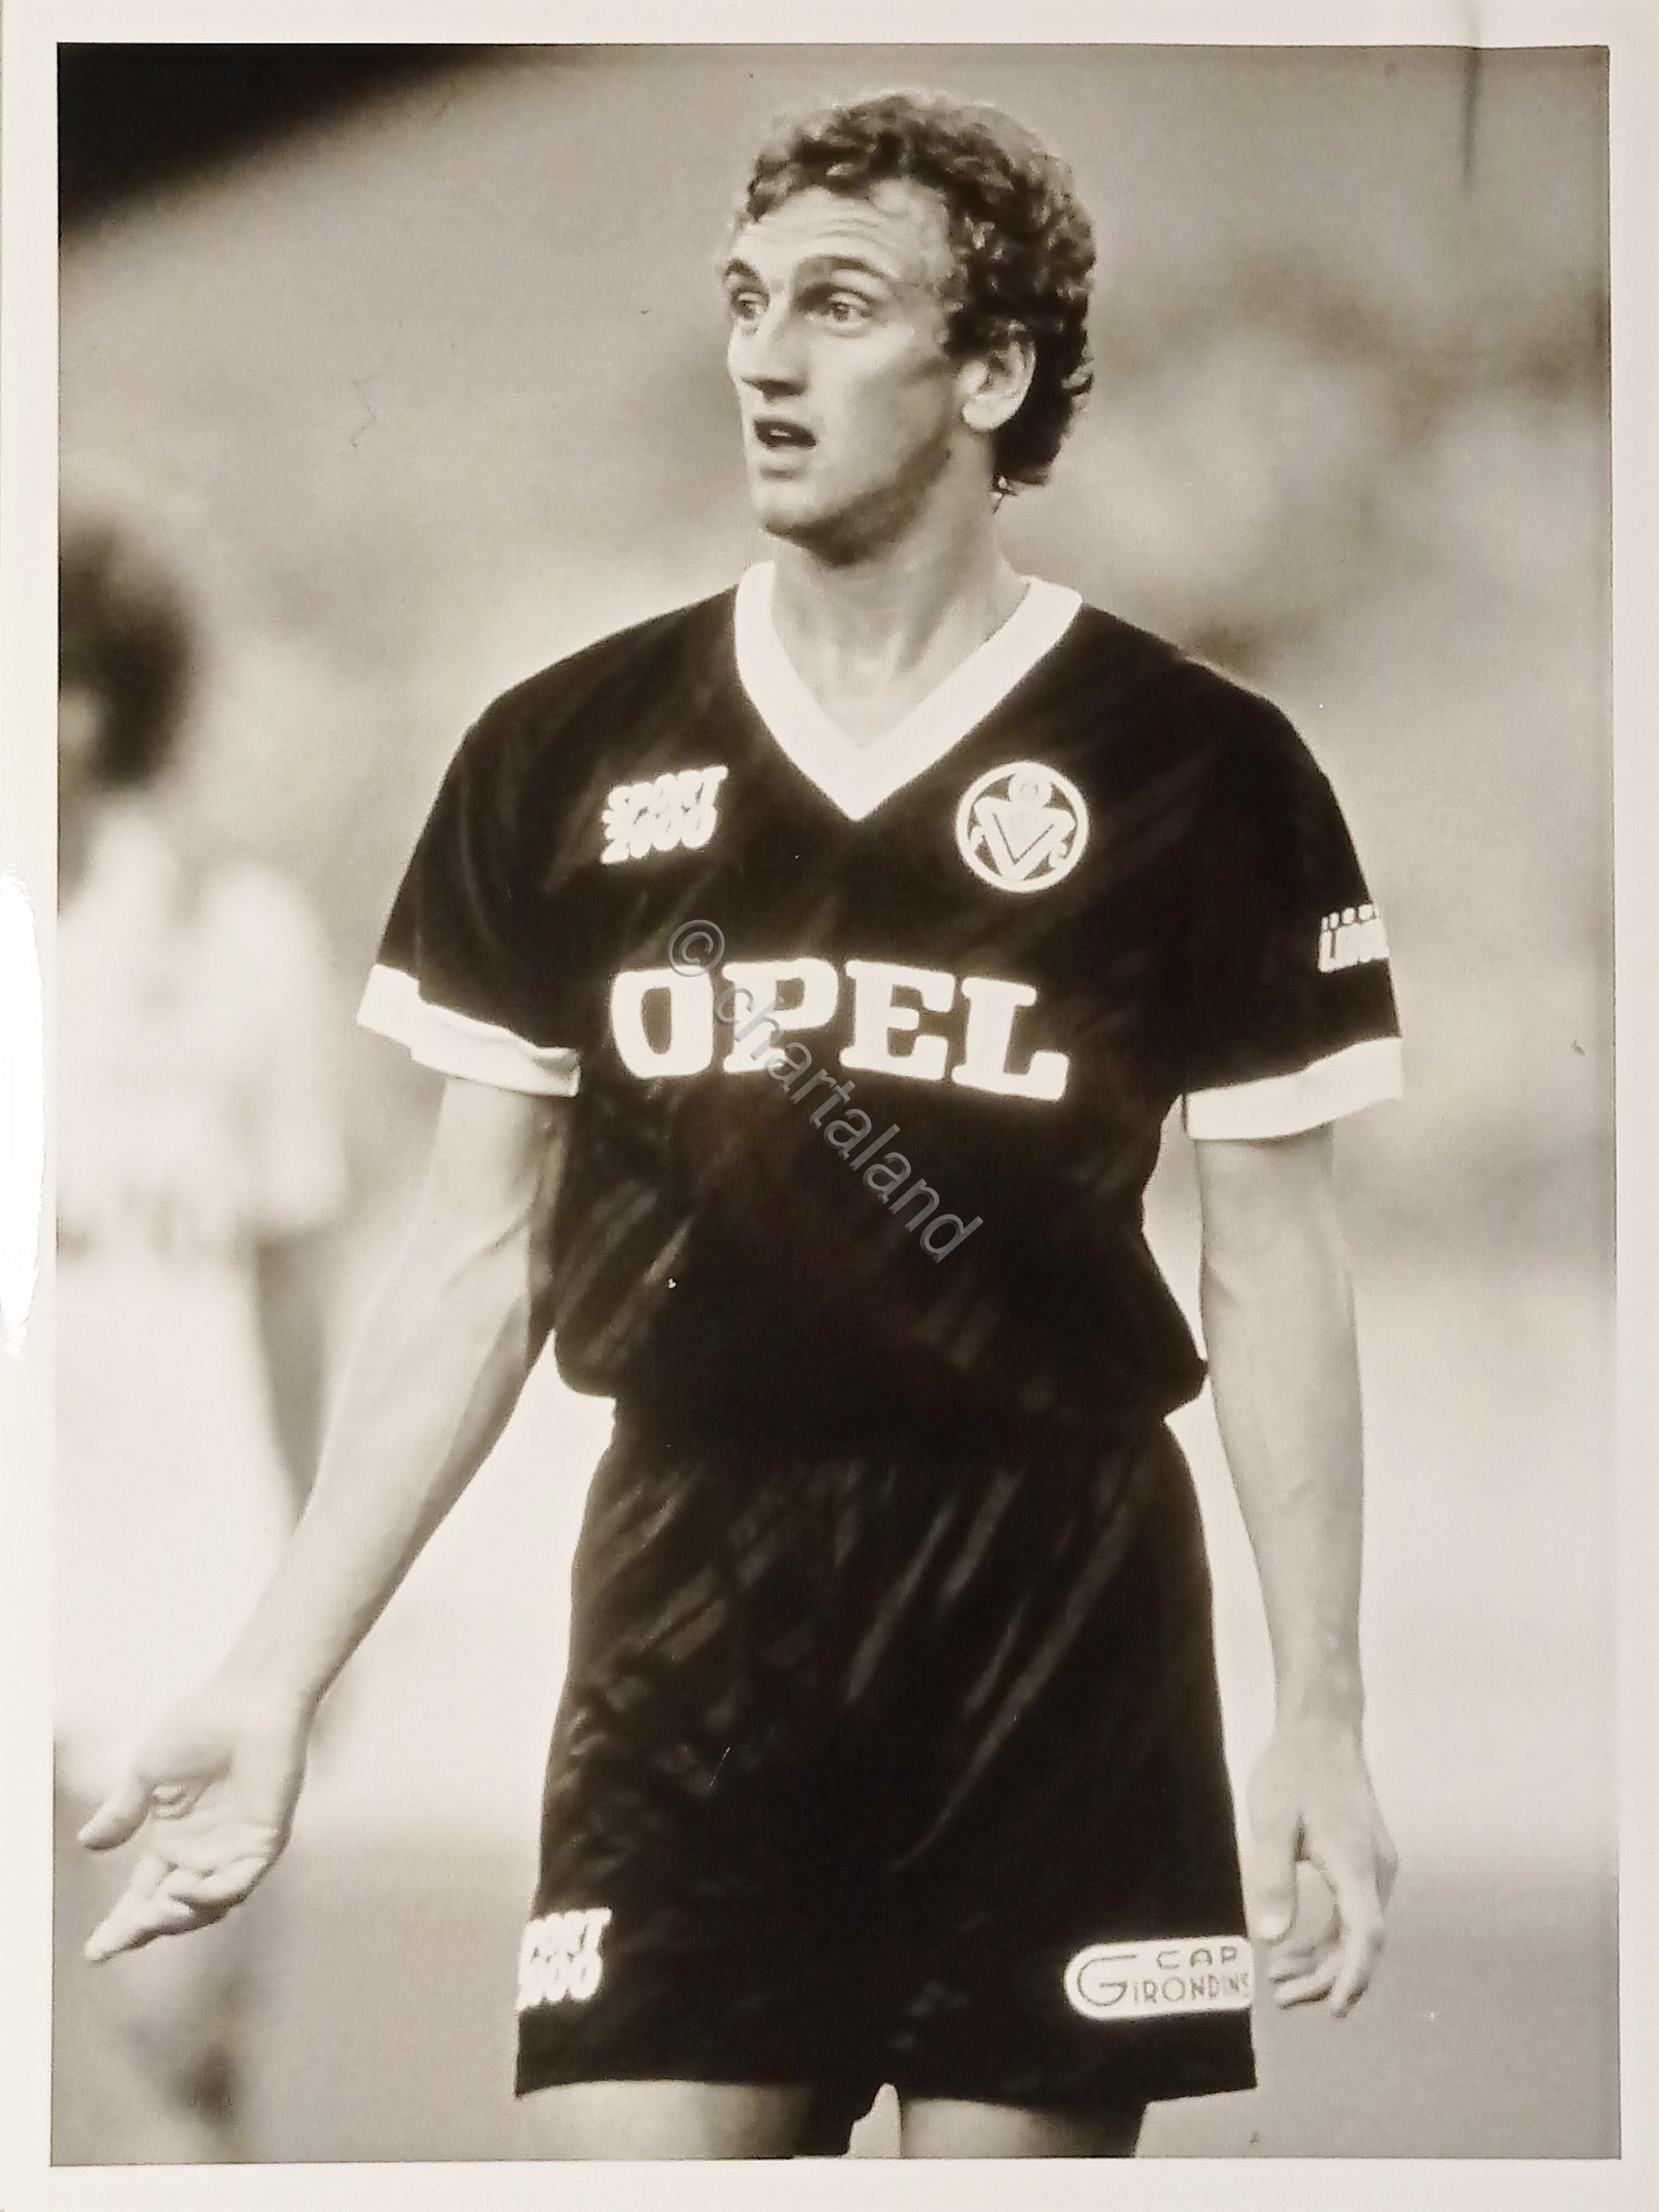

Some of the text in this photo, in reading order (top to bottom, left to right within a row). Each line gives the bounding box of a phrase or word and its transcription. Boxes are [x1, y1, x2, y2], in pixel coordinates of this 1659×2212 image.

[610, 957, 1070, 1101] OPEL
[521, 1907, 613, 1965] PORT
[1156, 1945, 1238, 1970] CAP
